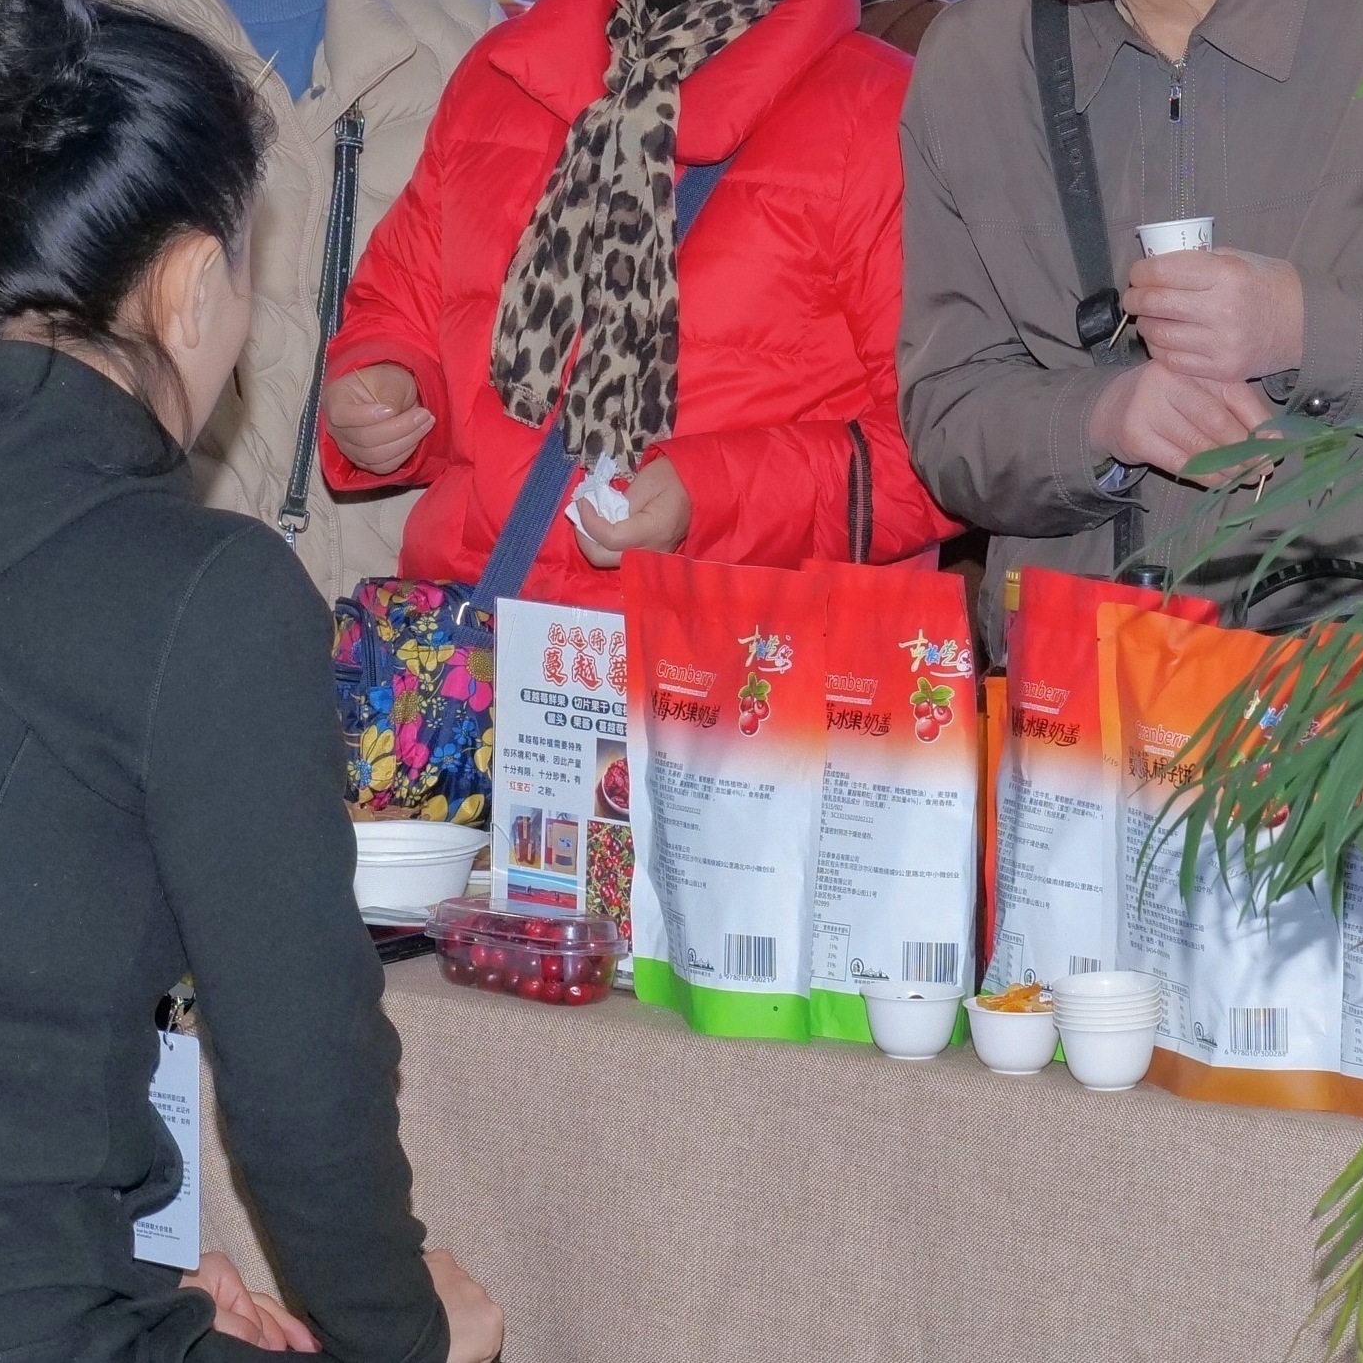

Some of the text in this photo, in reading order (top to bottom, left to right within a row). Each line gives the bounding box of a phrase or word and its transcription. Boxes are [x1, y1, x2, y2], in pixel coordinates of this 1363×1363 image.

[656, 658, 717, 691] Cranberry
[522, 688, 567, 707] 蔓越莓鲜果
[573, 696, 610, 714] 切片果干
[597, 719, 627, 736] 蔓越莓
[517, 732, 583, 753] 蔓越莓种植需要特殊
[1233, 1049, 1258, 1058] 978010
[1260, 1050, 1287, 1058] 300288
